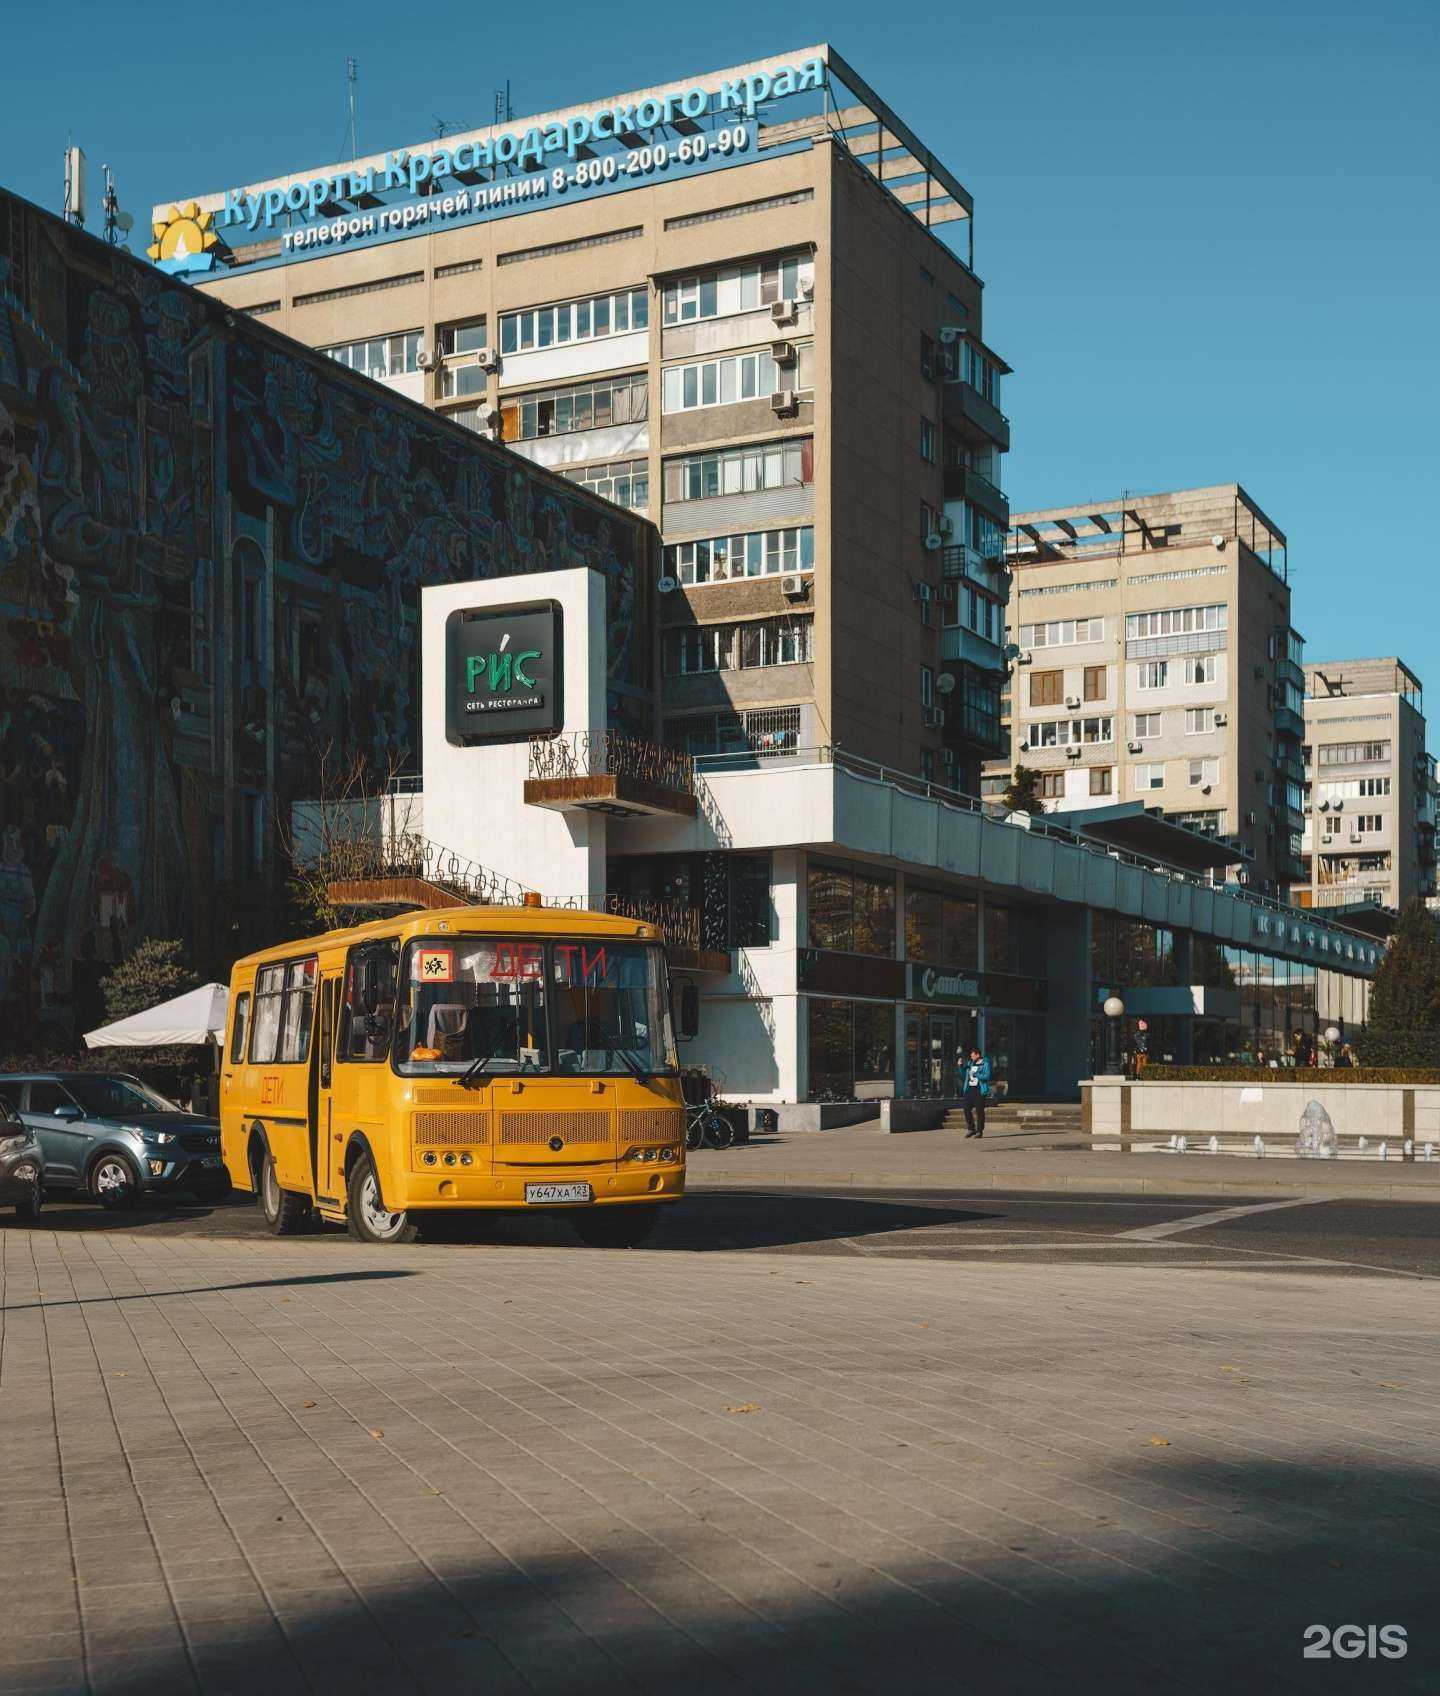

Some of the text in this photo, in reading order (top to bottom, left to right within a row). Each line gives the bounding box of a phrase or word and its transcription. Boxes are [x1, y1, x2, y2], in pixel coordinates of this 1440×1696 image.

[224, 57, 826, 230] Курорты Краснодарского края
[282, 126, 748, 249] телефон горячей линии 8-800-200-60-90
[467, 701, 485, 710] СЕТЬ
